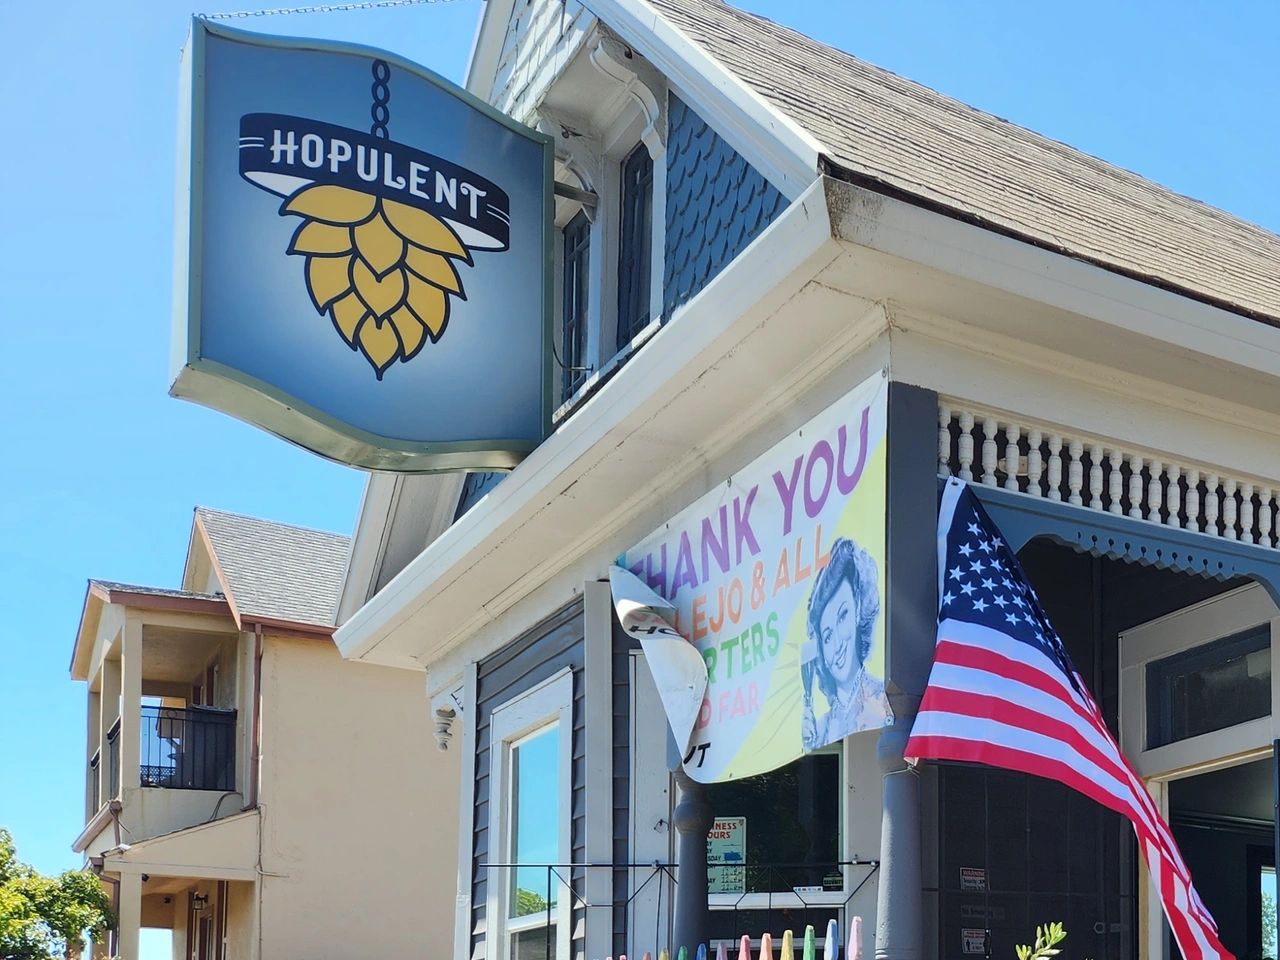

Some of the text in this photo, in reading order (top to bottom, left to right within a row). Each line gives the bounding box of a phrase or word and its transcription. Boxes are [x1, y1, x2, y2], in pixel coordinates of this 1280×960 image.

[270, 129, 487, 220] HOPULENT
[772, 406, 870, 536] YOU
[751, 560, 765, 610] &
[772, 524, 833, 598] ALL
[717, 680, 760, 724] FAR
